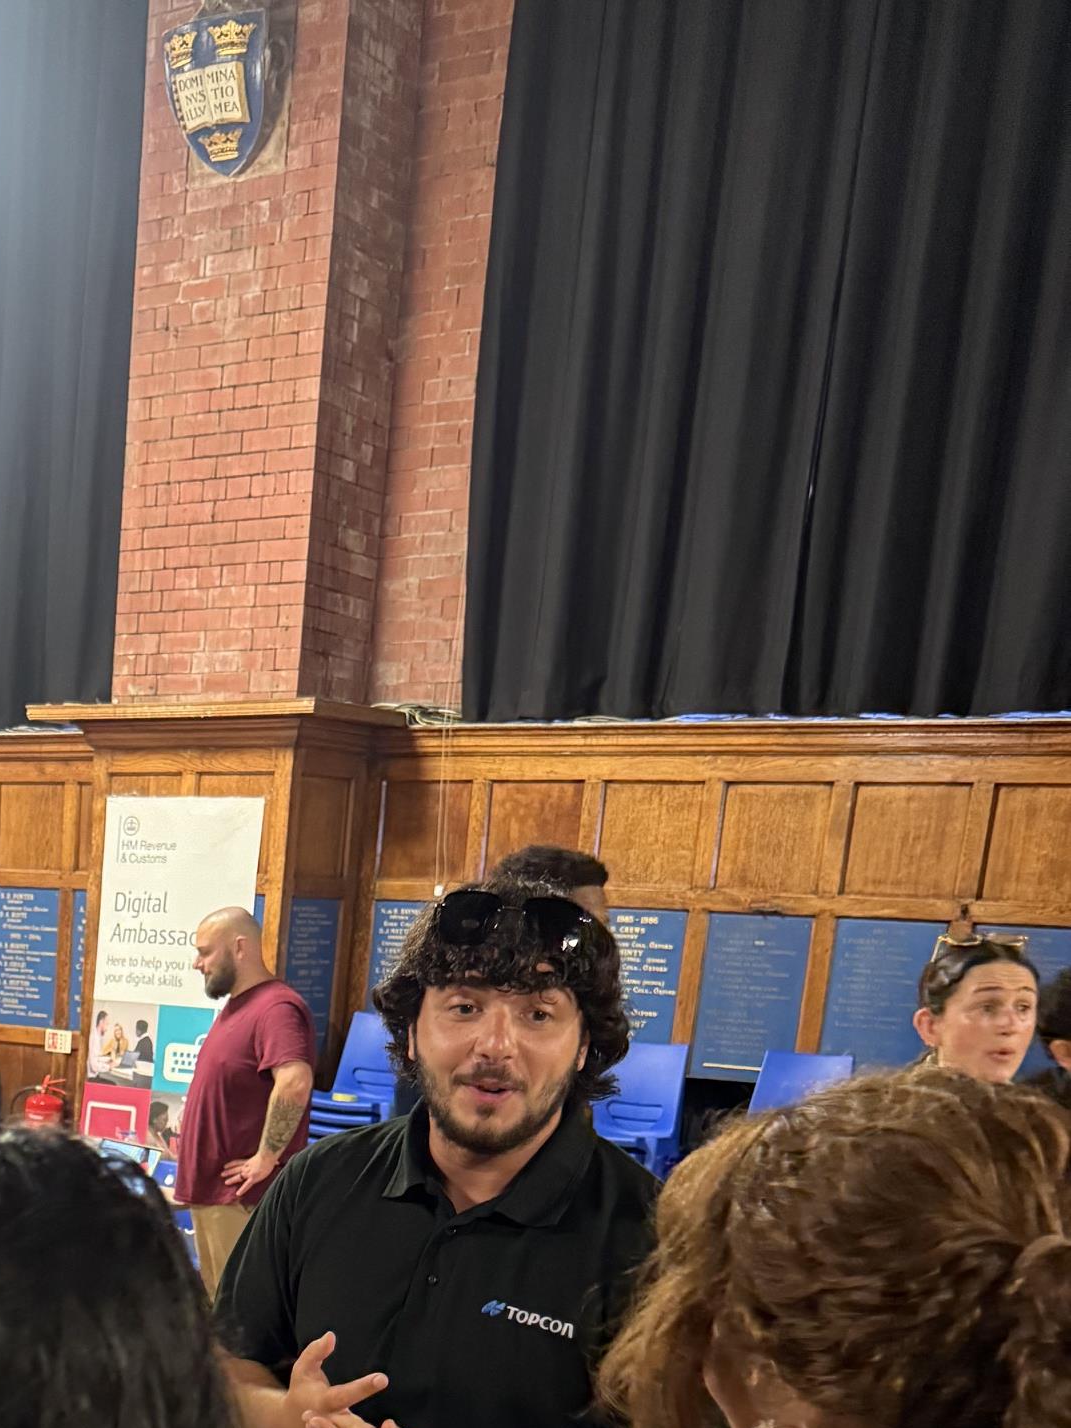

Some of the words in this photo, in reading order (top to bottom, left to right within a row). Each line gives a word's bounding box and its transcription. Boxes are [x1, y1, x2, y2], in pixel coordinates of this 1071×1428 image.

[210, 85, 234, 100] TIO
[213, 101, 240, 114] MEA
[121, 839, 138, 851] HM
[140, 840, 177, 852] Revenue
[120, 853, 127, 864] &
[128, 853, 168, 864] Customs
[114, 890, 168, 919] Digital
[105, 954, 126, 967] Here
[128, 955, 139, 967] to
[140, 955, 162, 971] help
[165, 959, 185, 973] you
[104, 972, 123, 985] your
[125, 971, 155, 988] digital
[157, 973, 183, 988] skills
[506, 1305, 574, 1339] TOPCON
